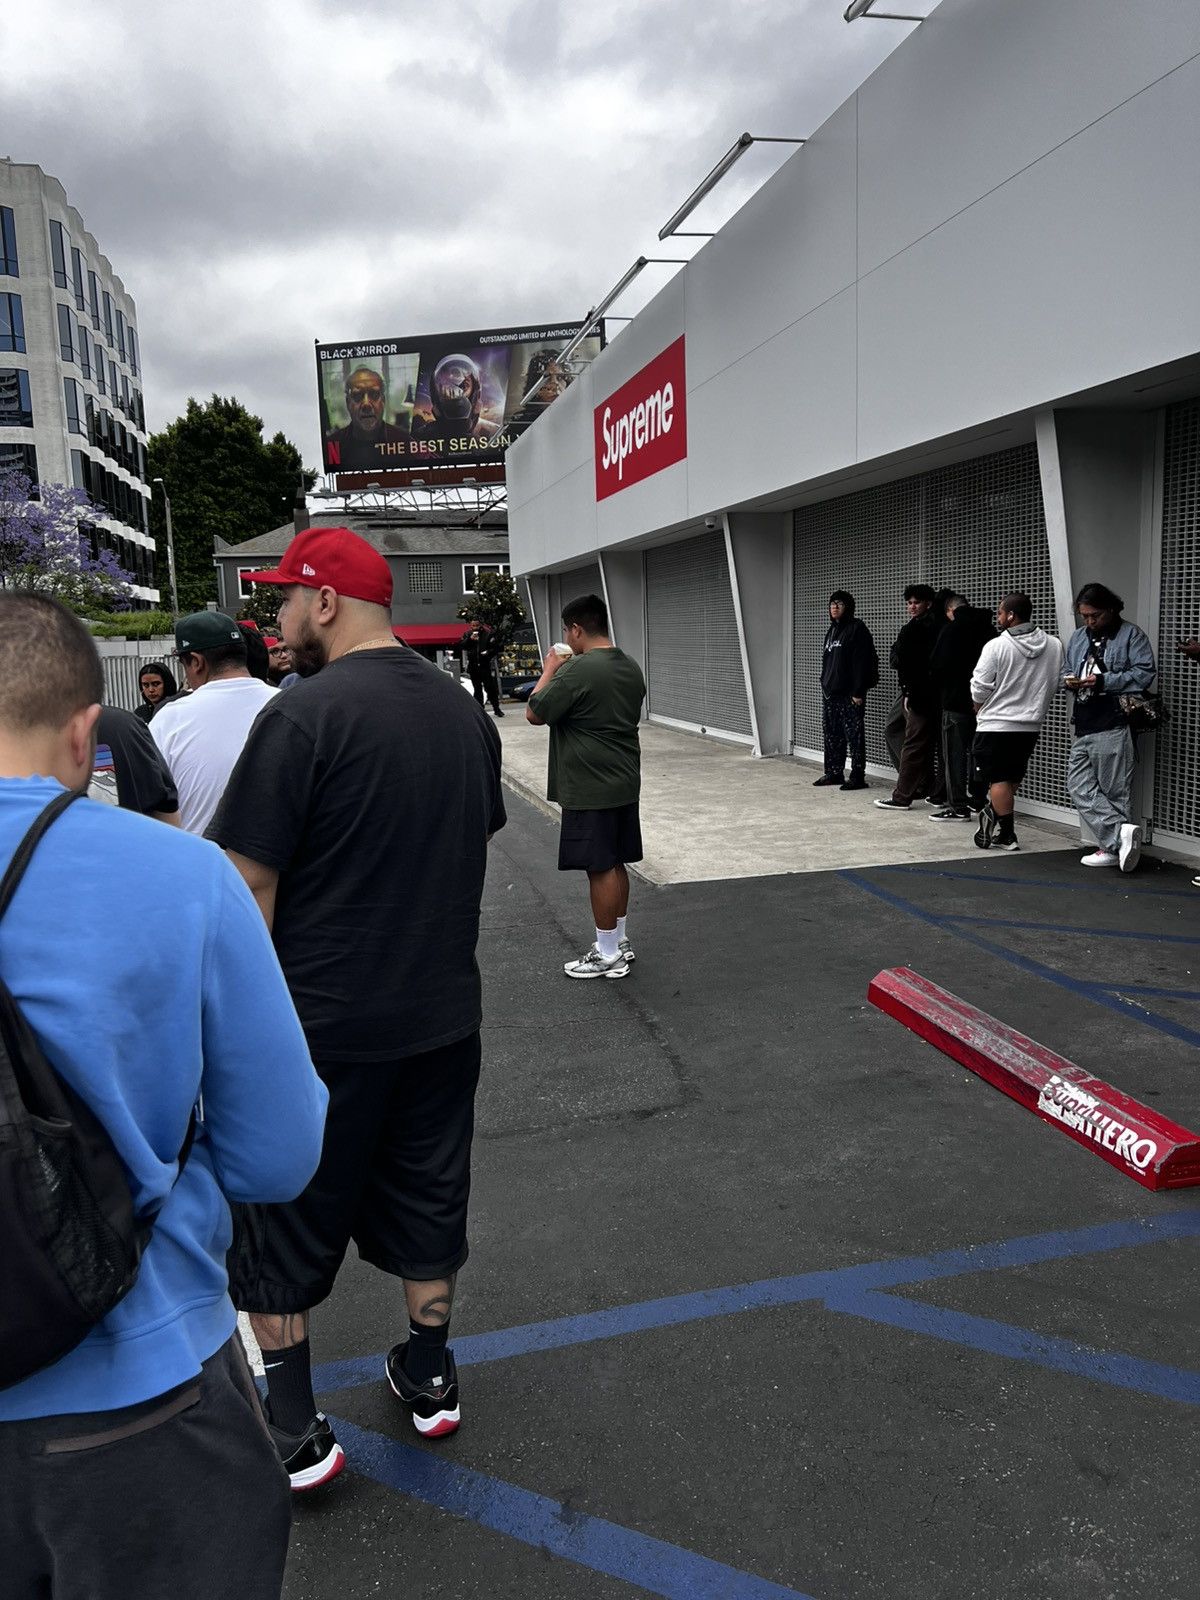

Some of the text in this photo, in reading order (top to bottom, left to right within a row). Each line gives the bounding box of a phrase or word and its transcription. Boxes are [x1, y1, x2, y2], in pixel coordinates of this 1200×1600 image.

[479, 333, 518, 344] OUTSTANDING
[518, 331, 539, 341] LIMITED
[320, 343, 398, 360] BLACK MIRROR
[602, 381, 674, 480] Supreme
[409, 439, 445, 454] BEST
[449, 435, 511, 451] SEASON
